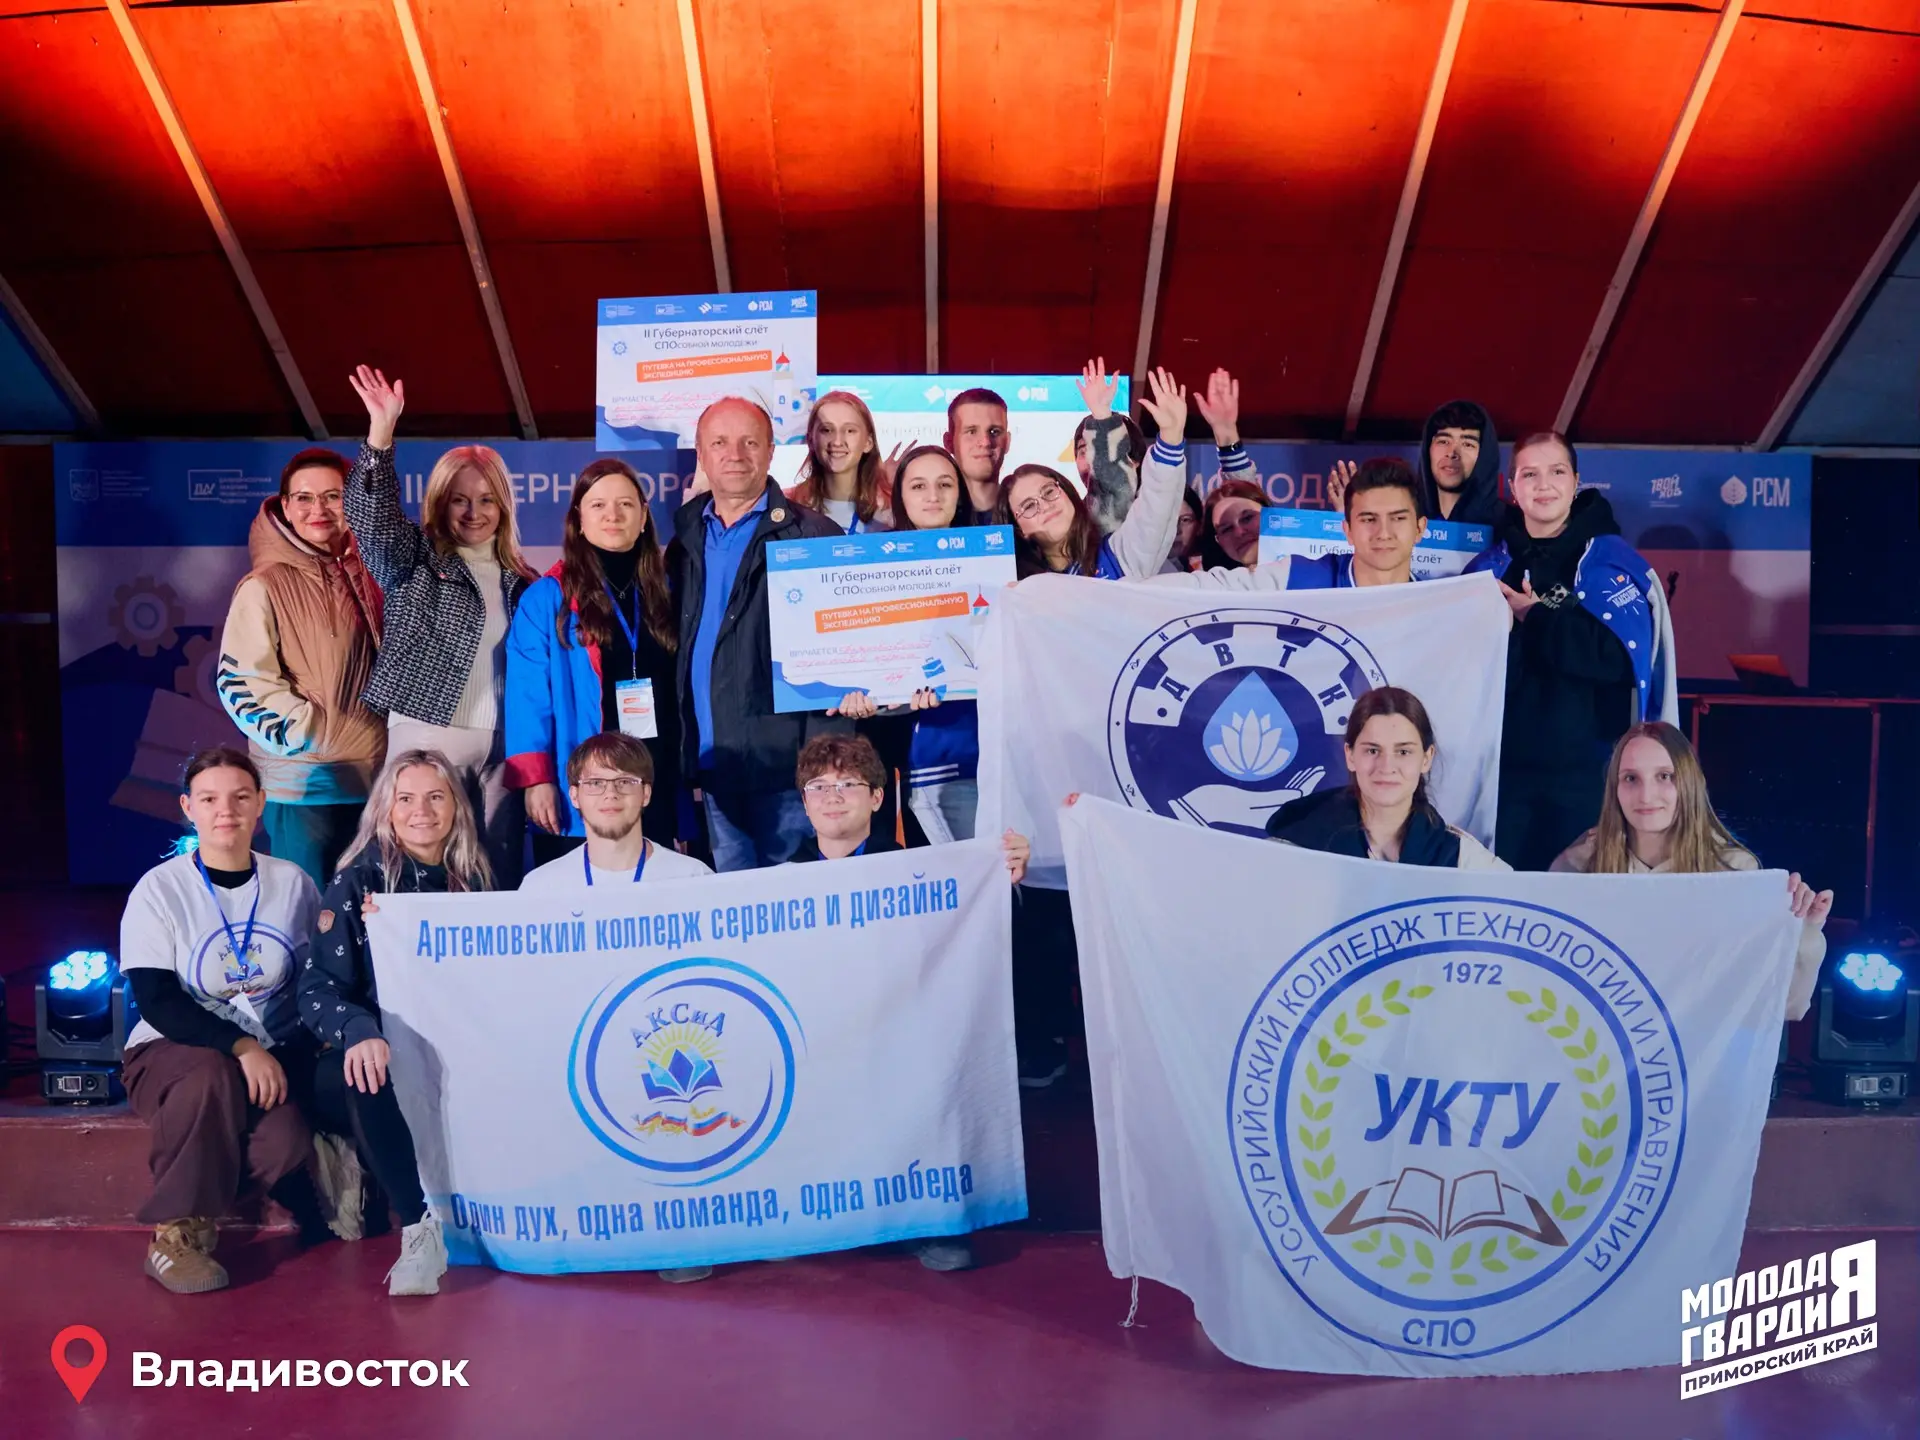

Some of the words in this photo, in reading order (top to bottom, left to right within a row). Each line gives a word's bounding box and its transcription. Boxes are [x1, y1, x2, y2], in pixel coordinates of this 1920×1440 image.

[653, 326, 741, 340] Губернаторский
[745, 324, 768, 335] слёт
[1752, 477, 1791, 507] РСМ
[1416, 553, 1442, 564] слёт
[831, 566, 932, 584] Губернаторский
[935, 564, 962, 575] слёт
[872, 596, 964, 613] ПРОФЕССИОНАЛЬНУЮ
[416, 910, 586, 963] Артемовский
[596, 910, 702, 951] колледж
[711, 896, 816, 943] сервиса
[825, 893, 841, 926] и
[850, 871, 958, 929] дизайна
[1278, 914, 1426, 1020] КОЛЛЕДЖ
[1434, 911, 1644, 1019] ТЕХНОЛОГИИ
[1441, 962, 1504, 985] 1972
[1634, 1018, 1660, 1046] И
[1363, 1073, 1561, 1149] УКТУ
[1237, 1015, 1319, 1277] УССУРИЙСКИЙ
[1584, 1047, 1674, 1274] УПРАВЛЕНИЯ
[450, 1192, 506, 1237] Один
[514, 1205, 568, 1242] дух,
[577, 1201, 644, 1241] одна
[653, 1188, 790, 1232] команда,
[800, 1179, 865, 1221] одна
[874, 1158, 974, 1208] победа
[1401, 1317, 1476, 1347] СПО
